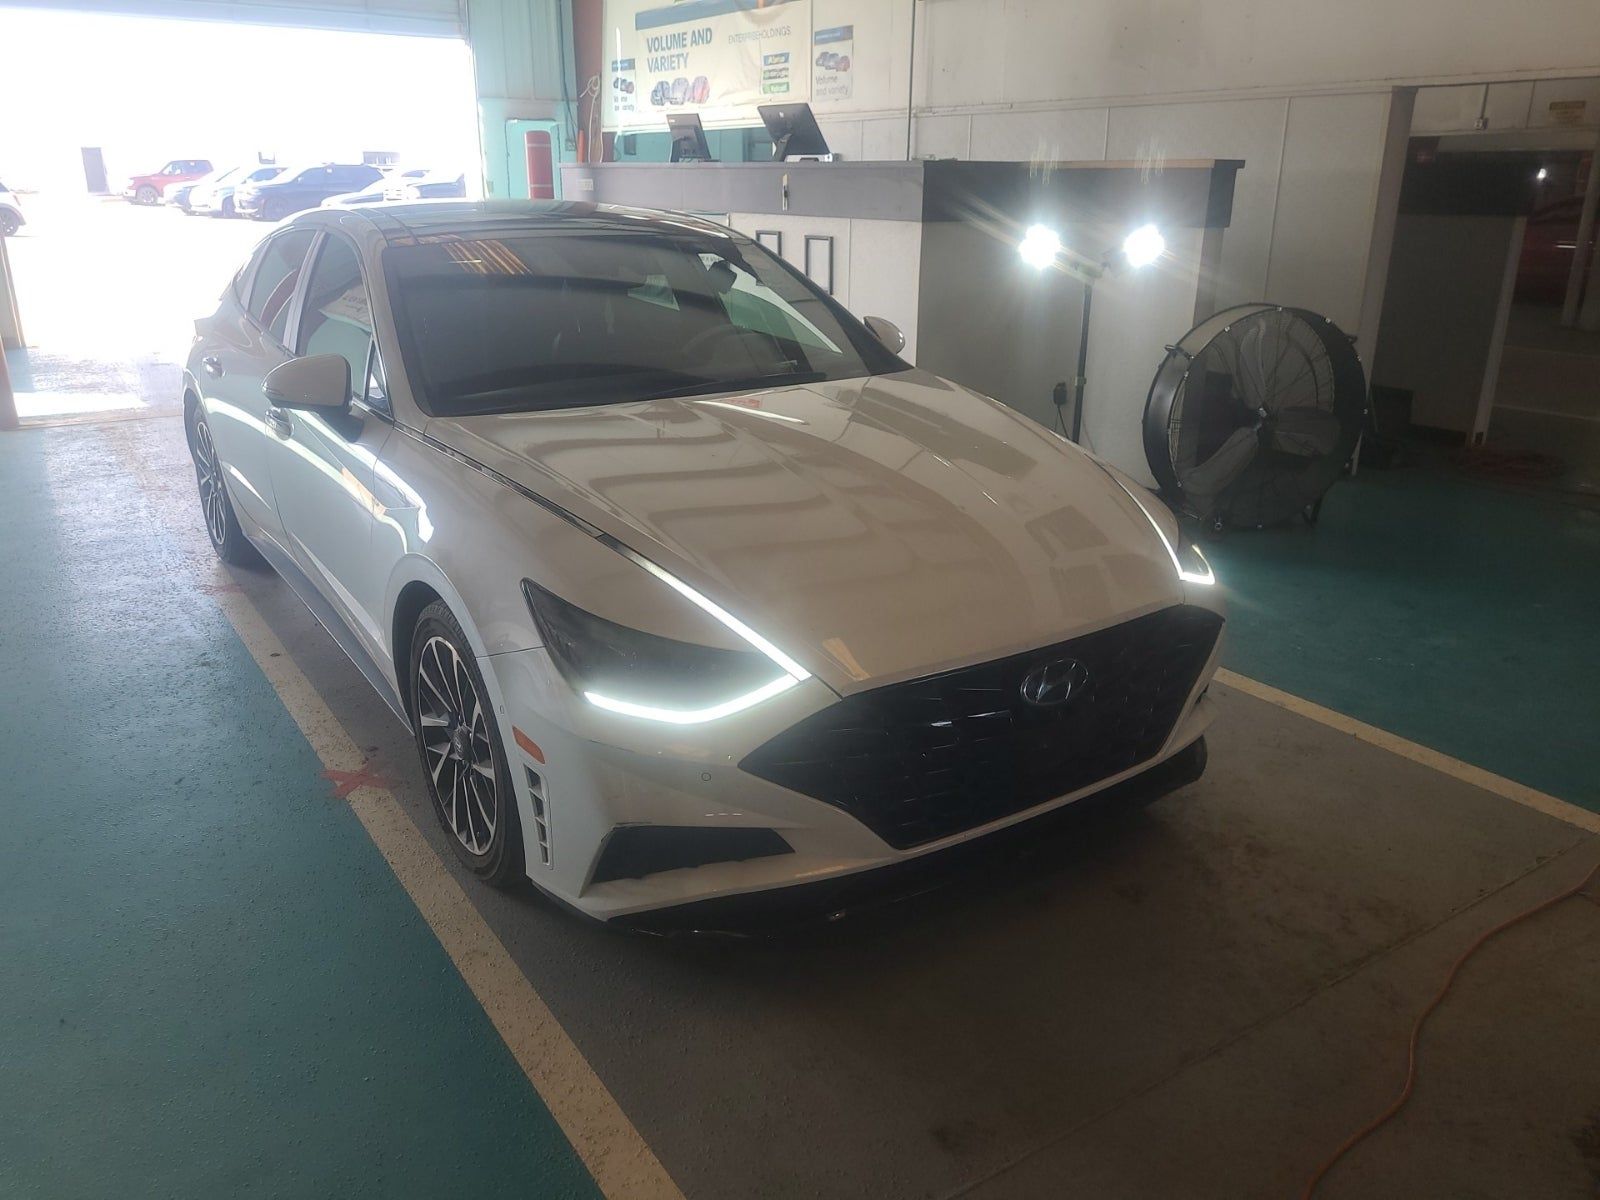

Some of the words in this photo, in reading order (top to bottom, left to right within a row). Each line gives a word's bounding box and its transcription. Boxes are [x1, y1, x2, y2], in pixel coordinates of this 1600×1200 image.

[646, 32, 688, 53] VOLUME
[690, 27, 713, 47] AND
[646, 52, 689, 73] VARIETY
[815, 75, 838, 85] Volume
